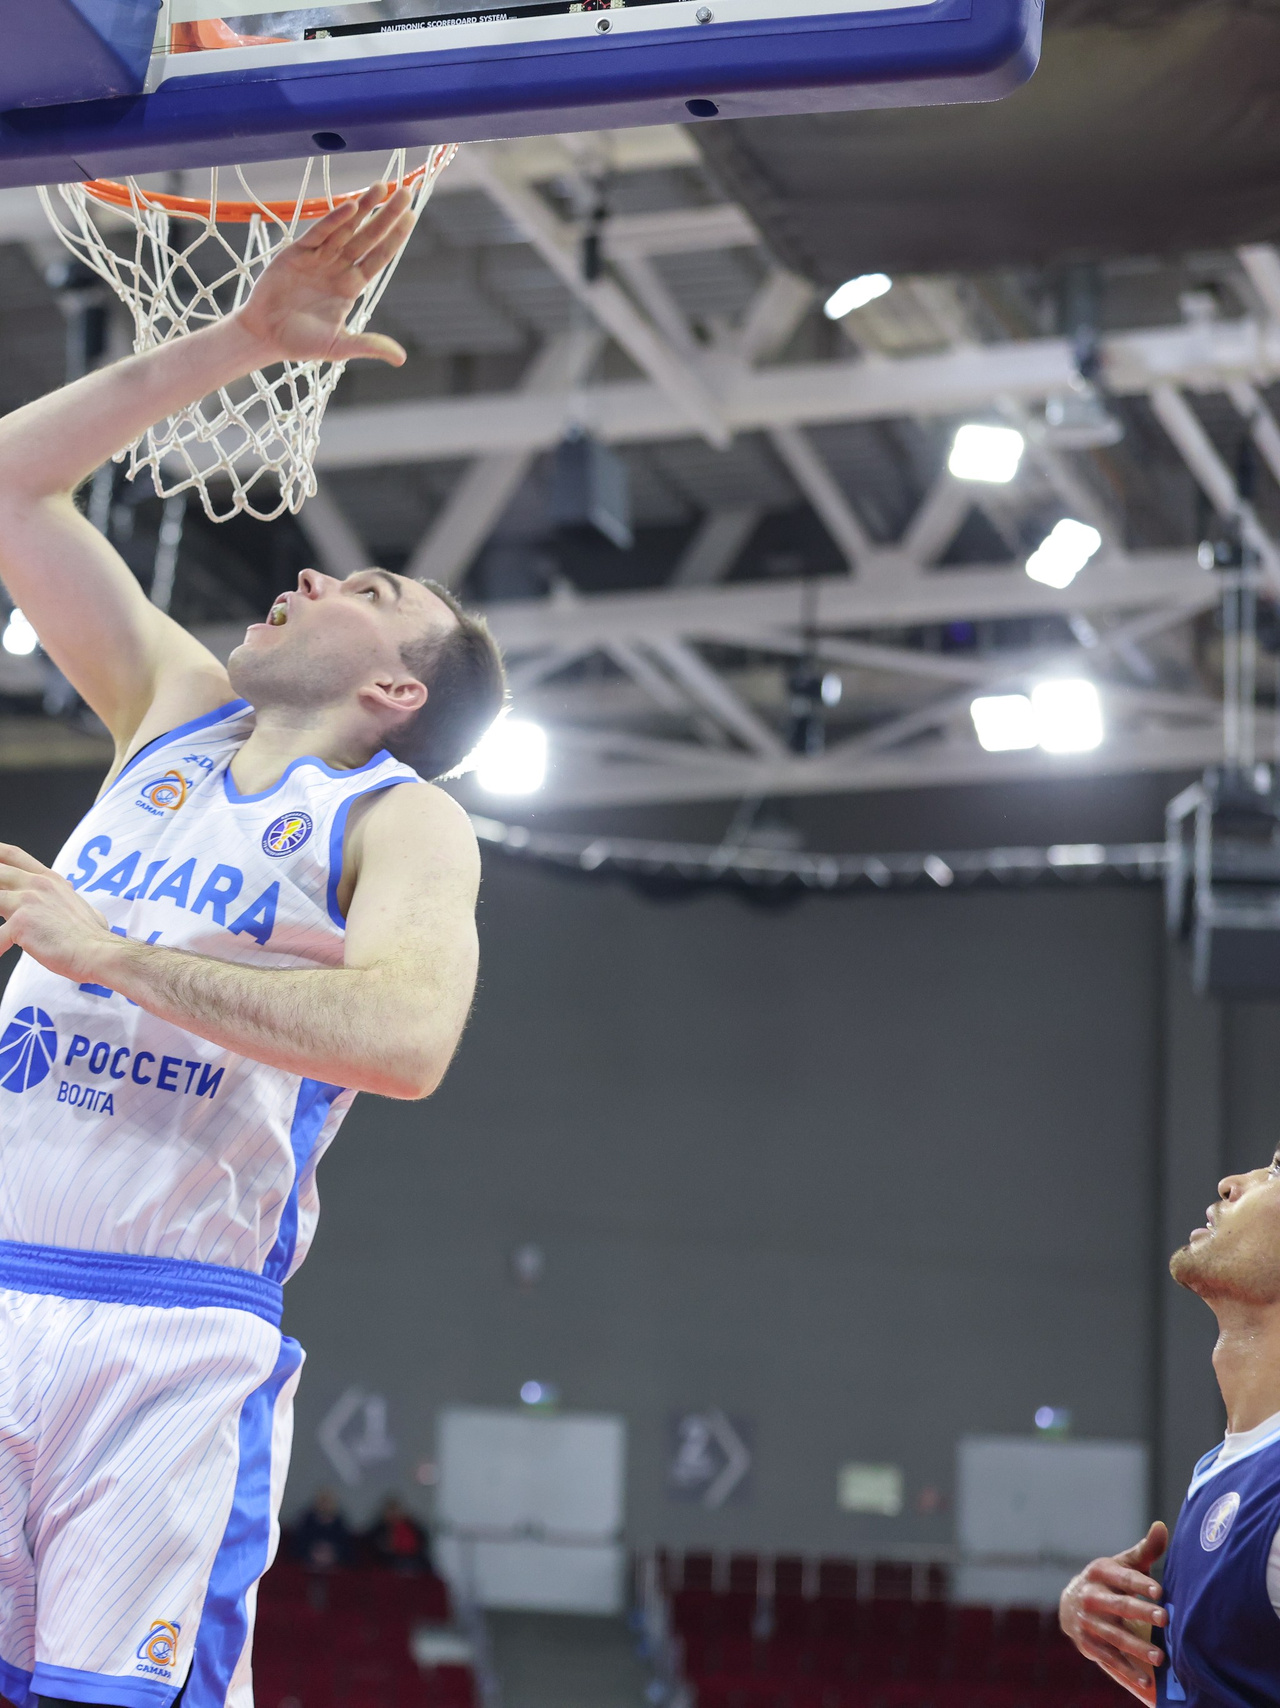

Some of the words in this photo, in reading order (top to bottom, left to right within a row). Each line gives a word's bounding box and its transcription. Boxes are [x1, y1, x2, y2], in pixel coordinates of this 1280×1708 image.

[380, 22, 426, 33] NAUTRONIC
[427, 16, 477, 28] SCOREBOARD
[479, 13, 508, 23] SYSTEM
[64, 1034, 226, 1099] РОССЕТИ
[56, 1080, 115, 1116] ВОЛГА
